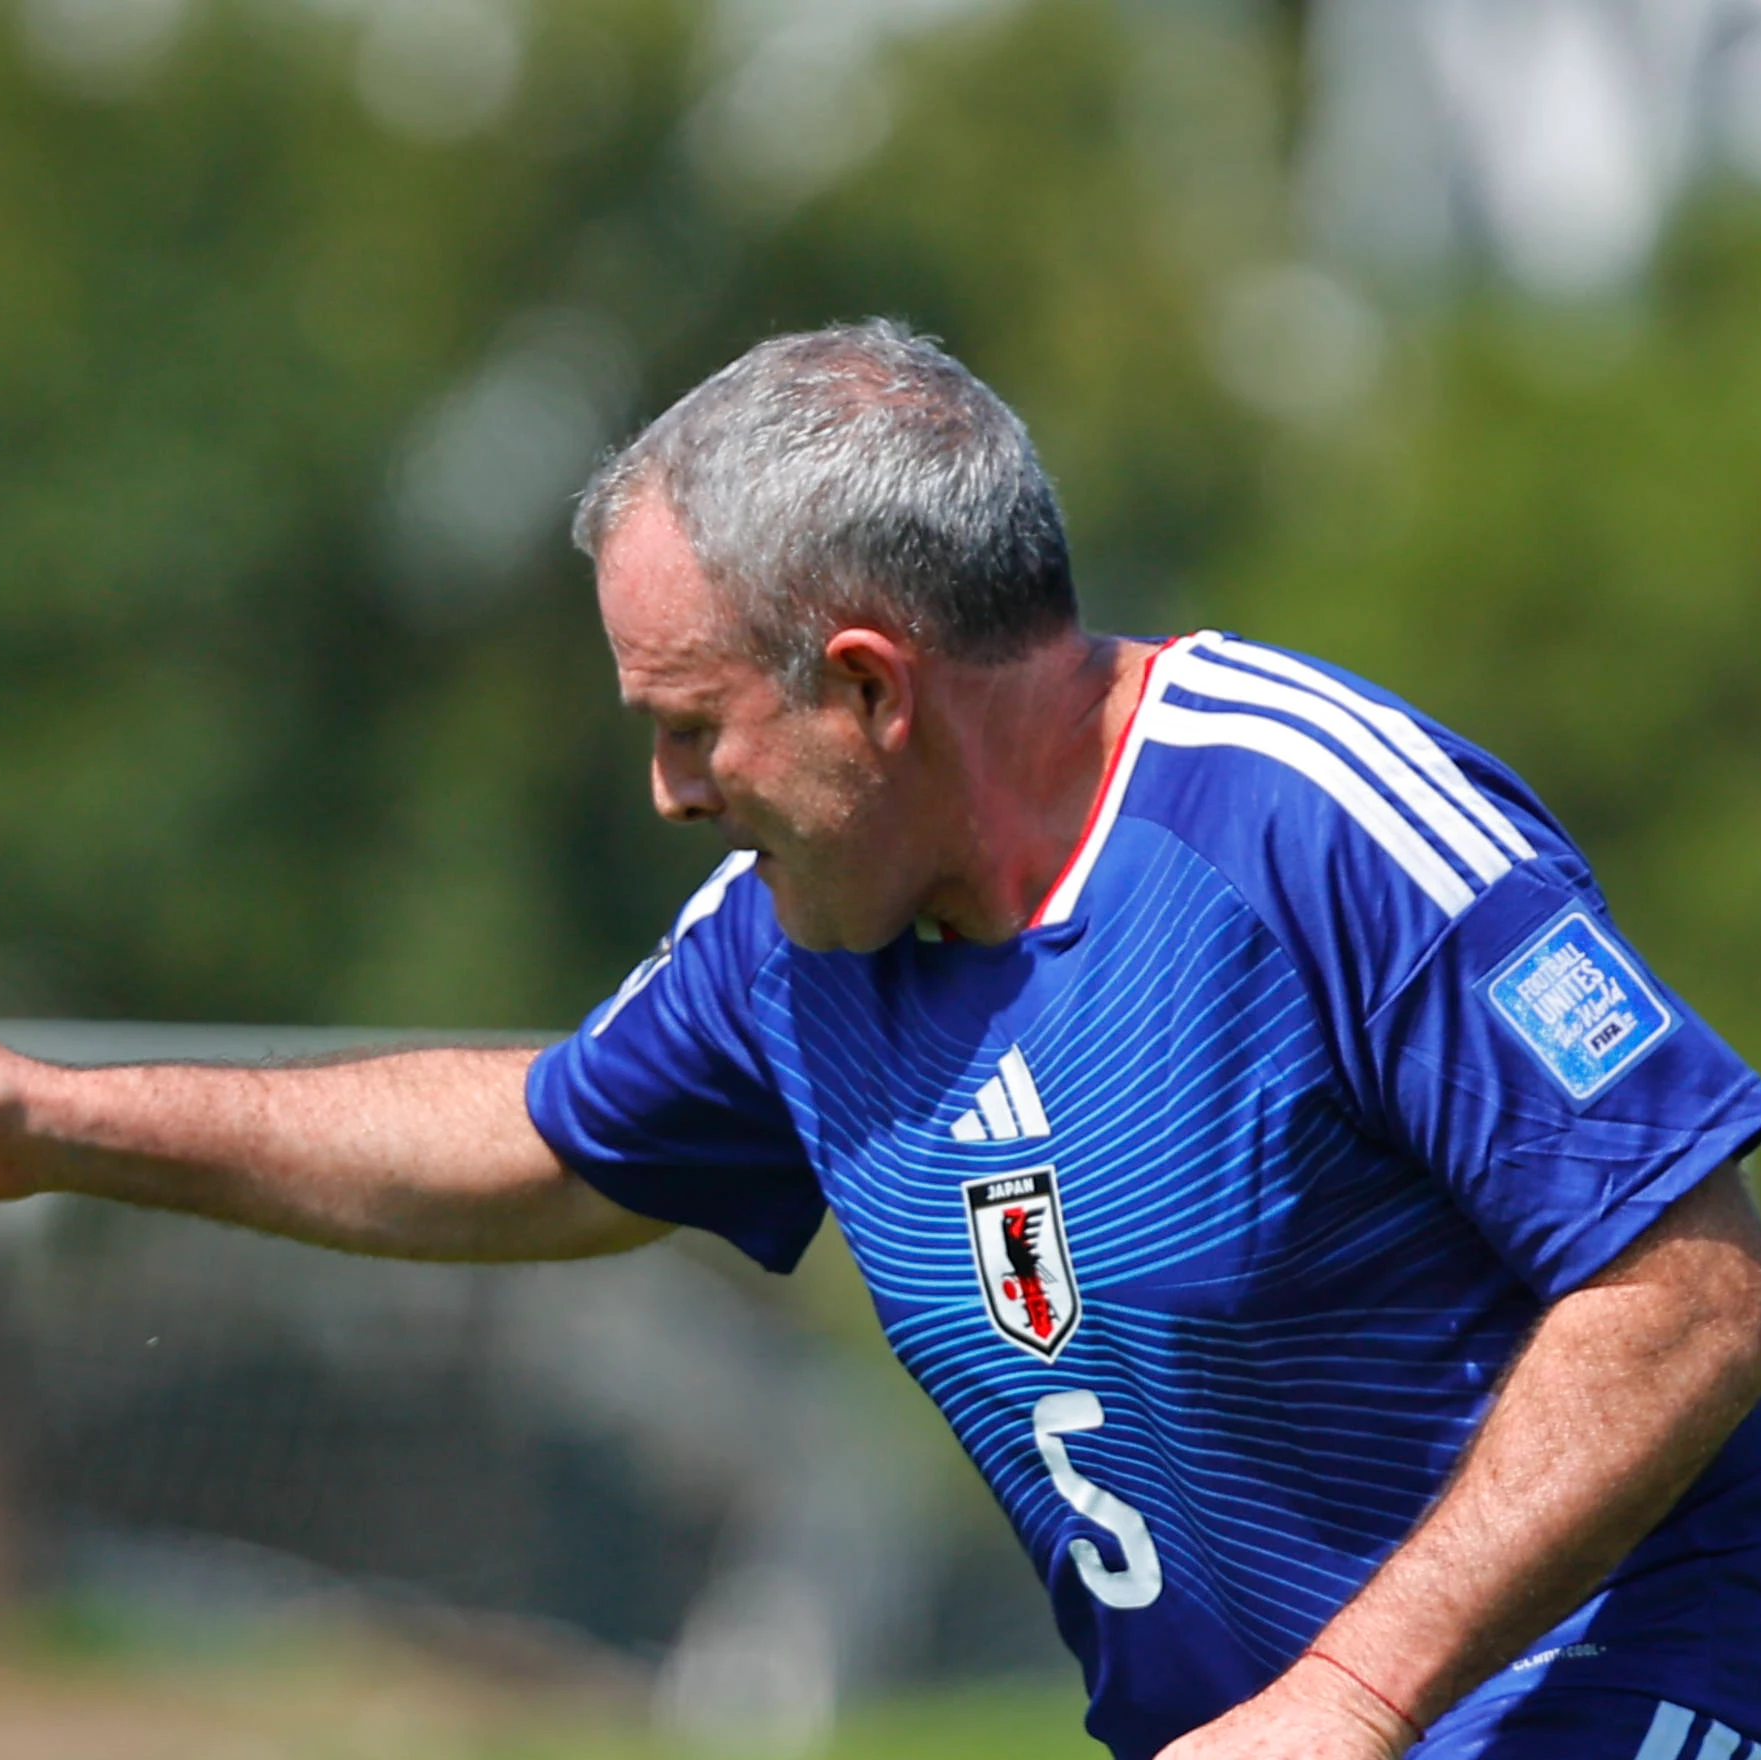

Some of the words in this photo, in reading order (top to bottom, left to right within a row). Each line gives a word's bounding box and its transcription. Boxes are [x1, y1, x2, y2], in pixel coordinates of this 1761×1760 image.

[1516, 941, 1585, 1002] FOOTBALL
[1532, 957, 1605, 1025] UNITES
[1590, 1022, 1622, 1050] FIFA
[986, 1177, 1035, 1201] JAPAN
[1033, 1389, 1162, 1608] 5
